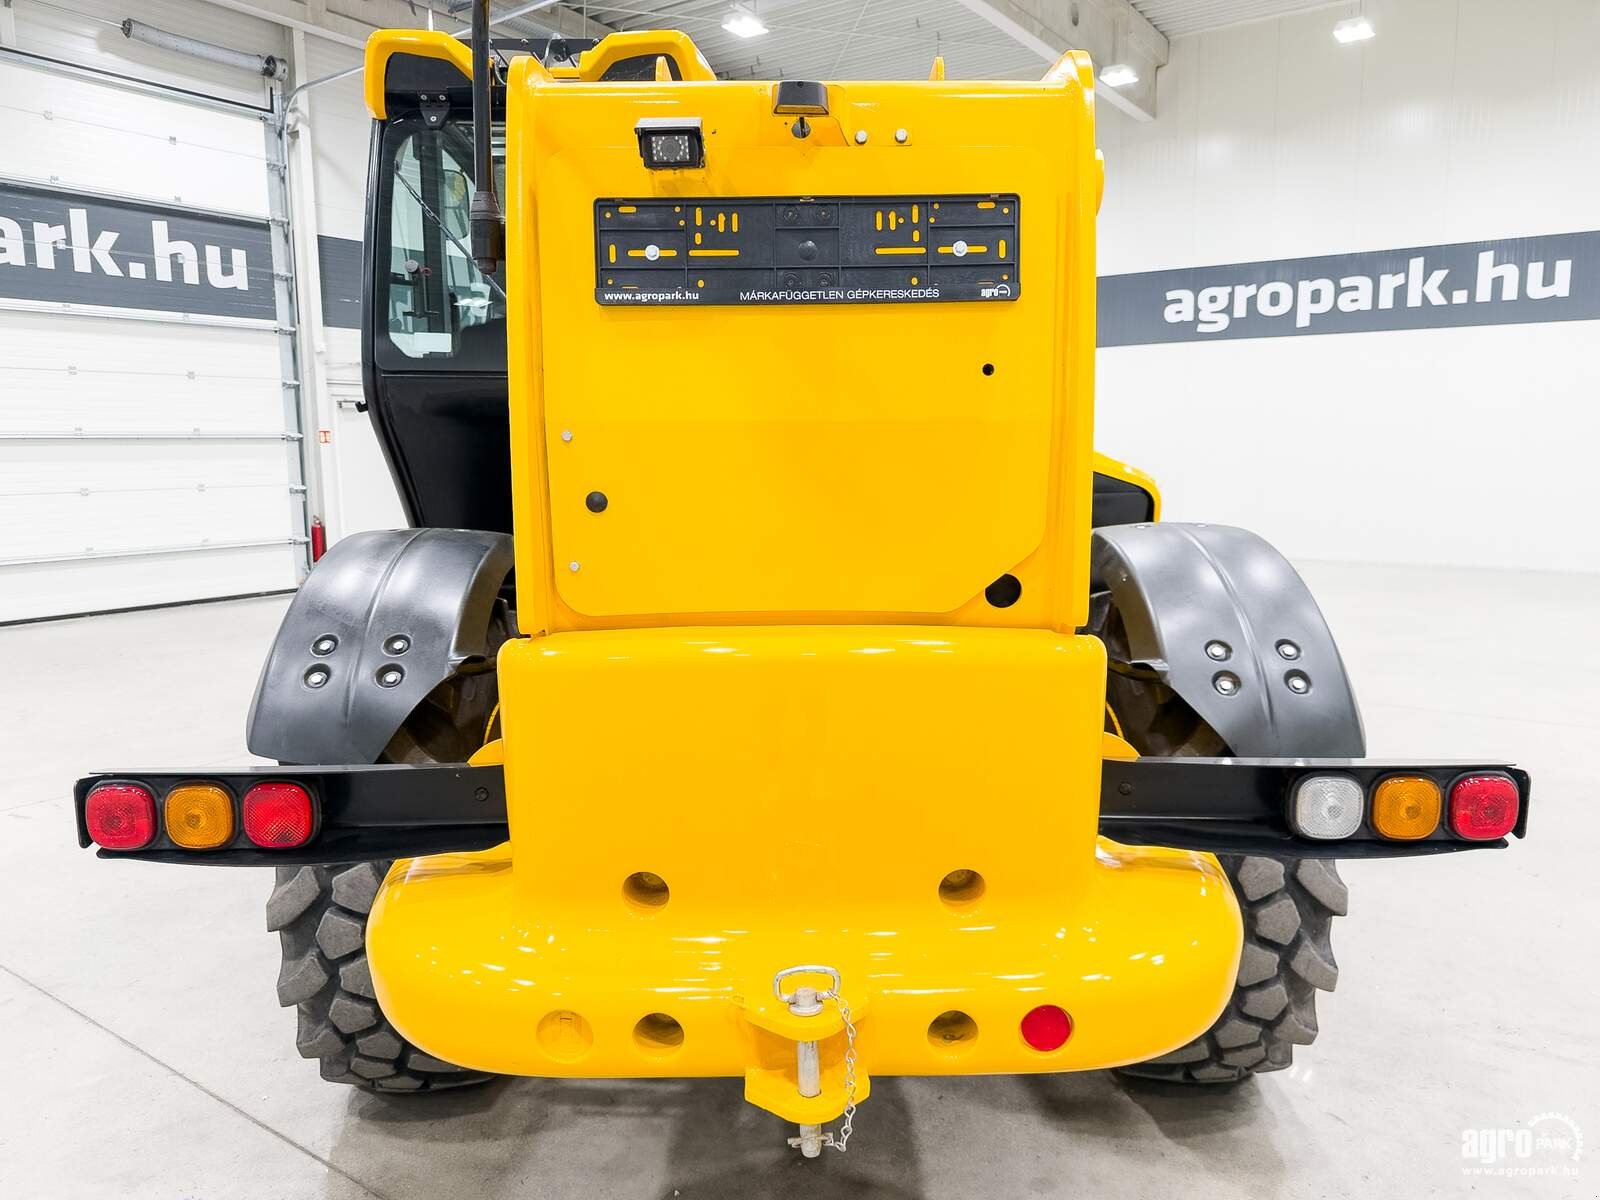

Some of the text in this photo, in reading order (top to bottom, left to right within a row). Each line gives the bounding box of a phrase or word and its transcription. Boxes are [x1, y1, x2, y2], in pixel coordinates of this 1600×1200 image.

[604, 290, 700, 303] www.agropark.hu
[739, 287, 940, 302] MÁRKAFÜGGETLEN GÉPKERESKEDÉS
[1163, 250, 1573, 333] agropark.hu
